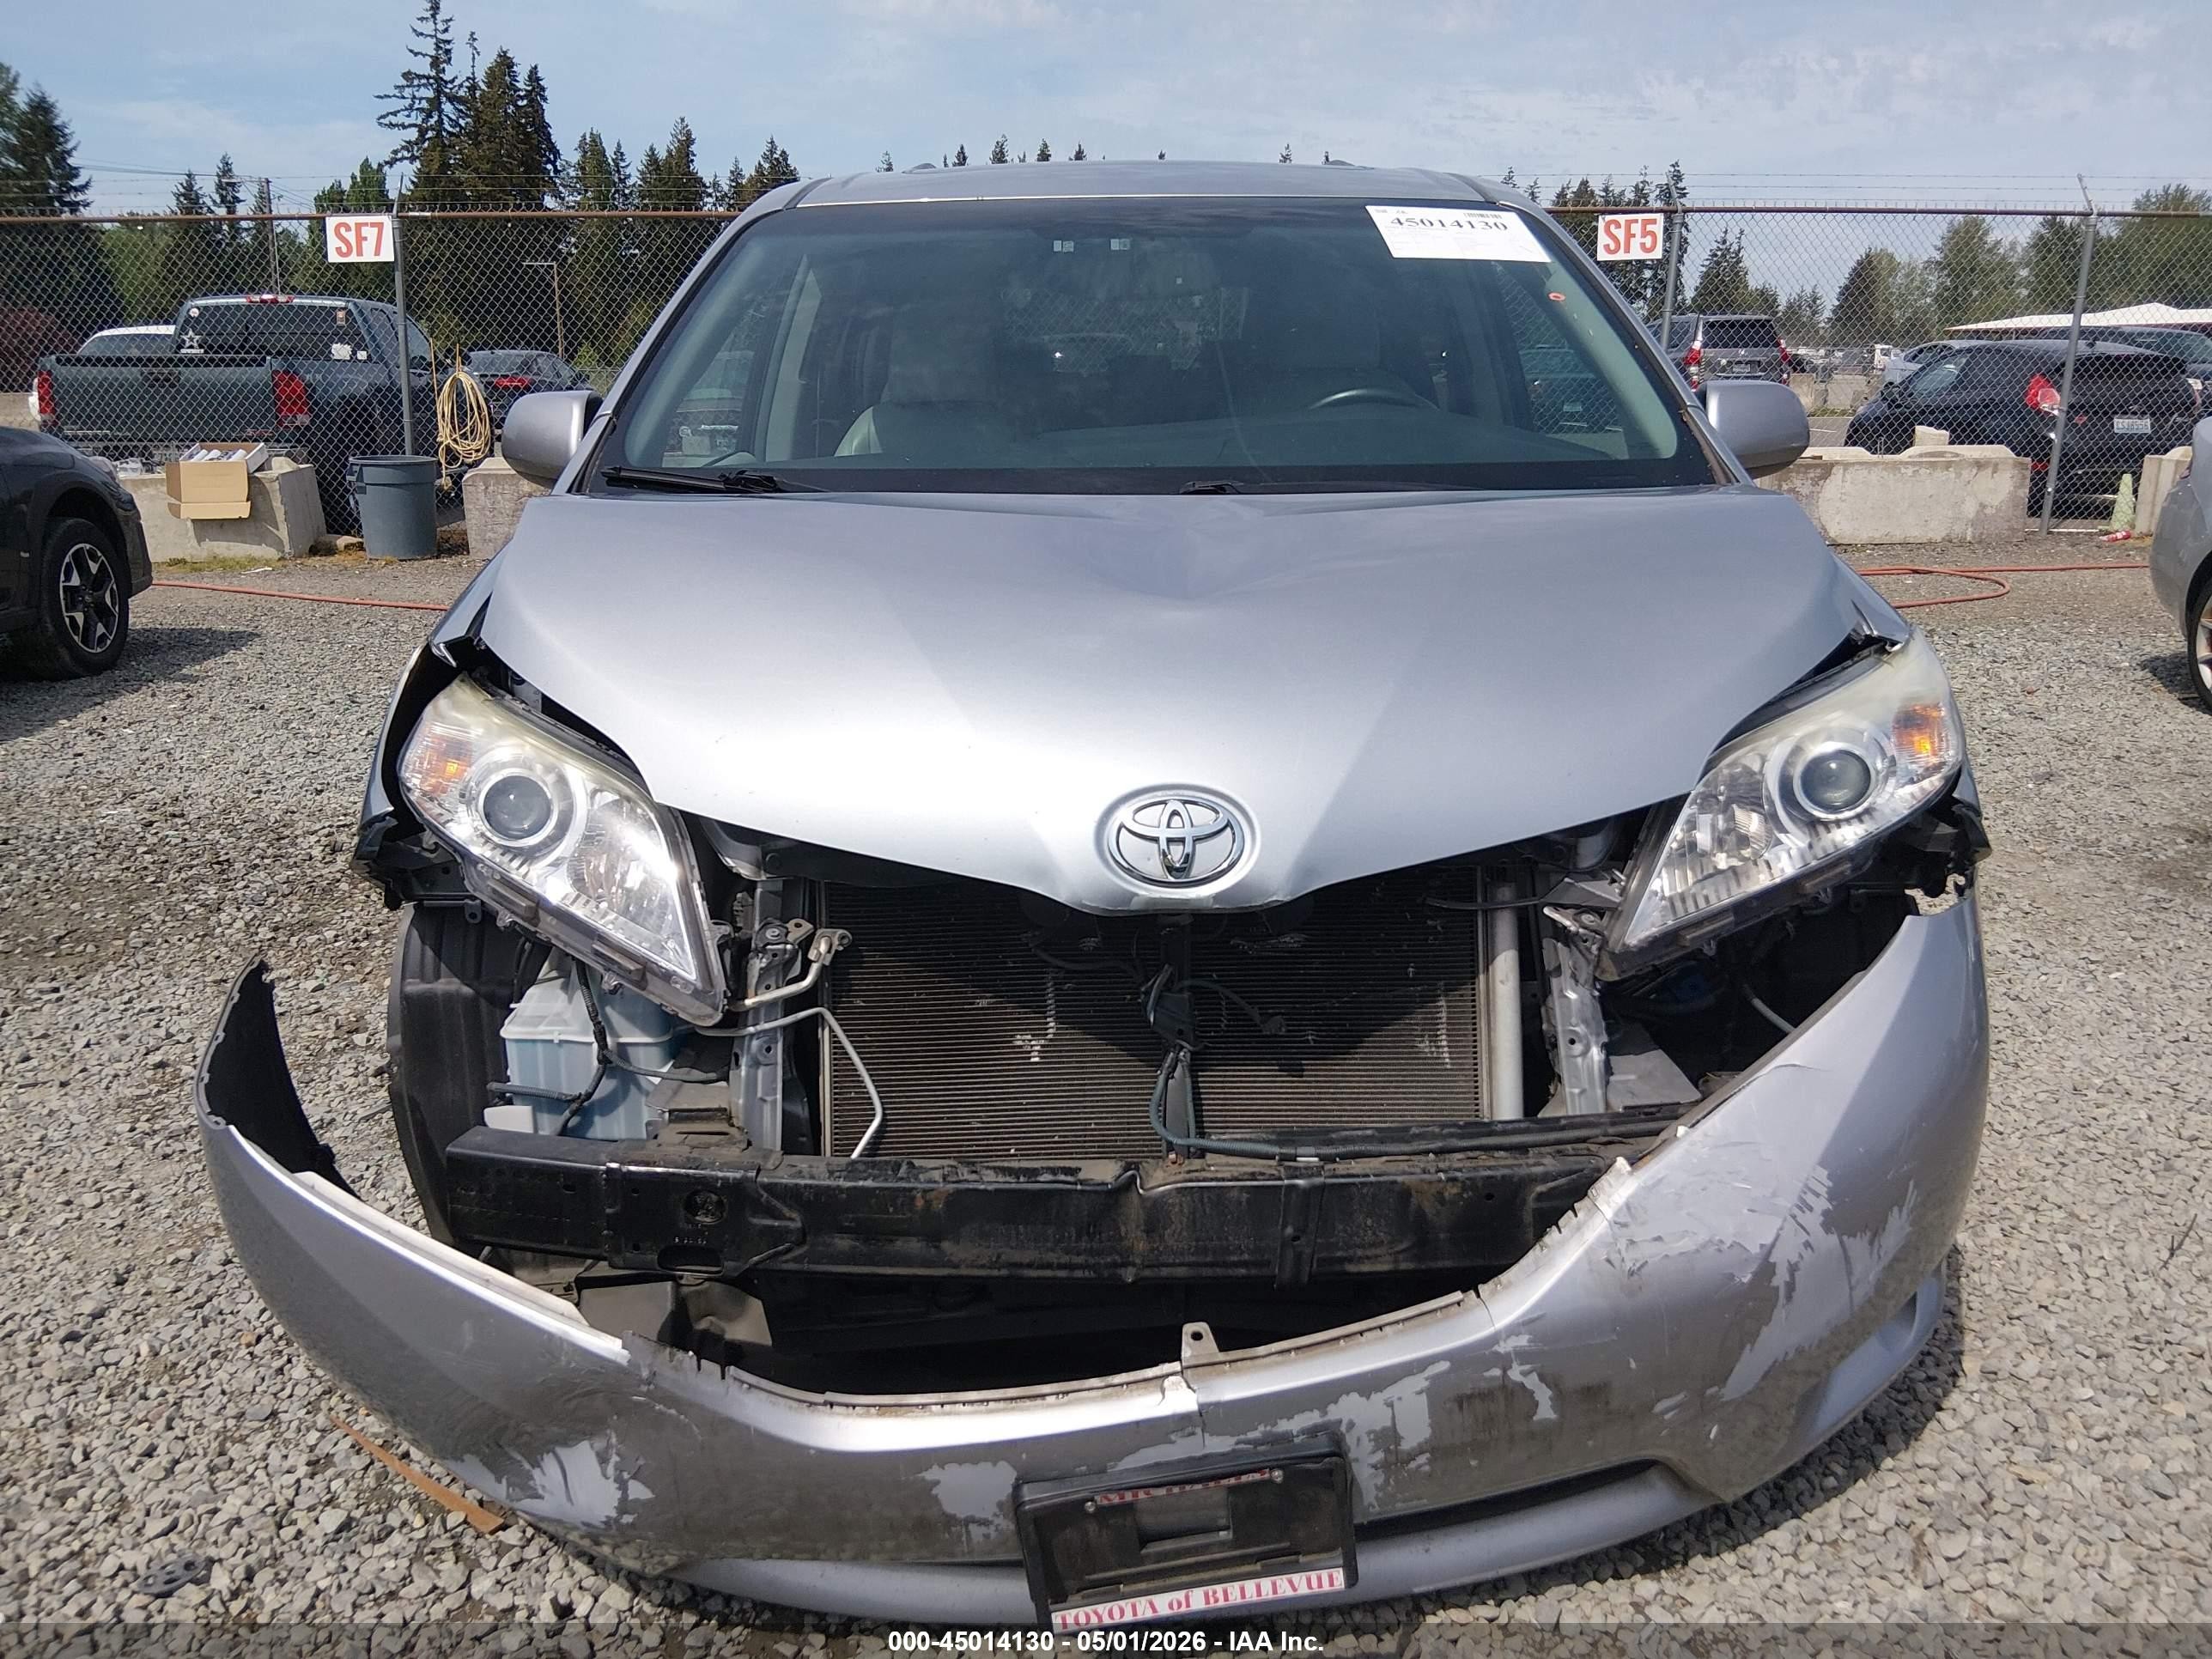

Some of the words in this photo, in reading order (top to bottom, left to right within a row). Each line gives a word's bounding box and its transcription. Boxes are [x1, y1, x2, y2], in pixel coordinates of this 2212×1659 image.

[333, 222, 385, 258] SF7
[1390, 216, 1508, 231] 45014130
[1602, 218, 1657, 255] SF5
[1055, 1597, 1159, 1630] TOYOTA
[1167, 1589, 1194, 1612] of
[1202, 1570, 1343, 1607] BELLEVUE
